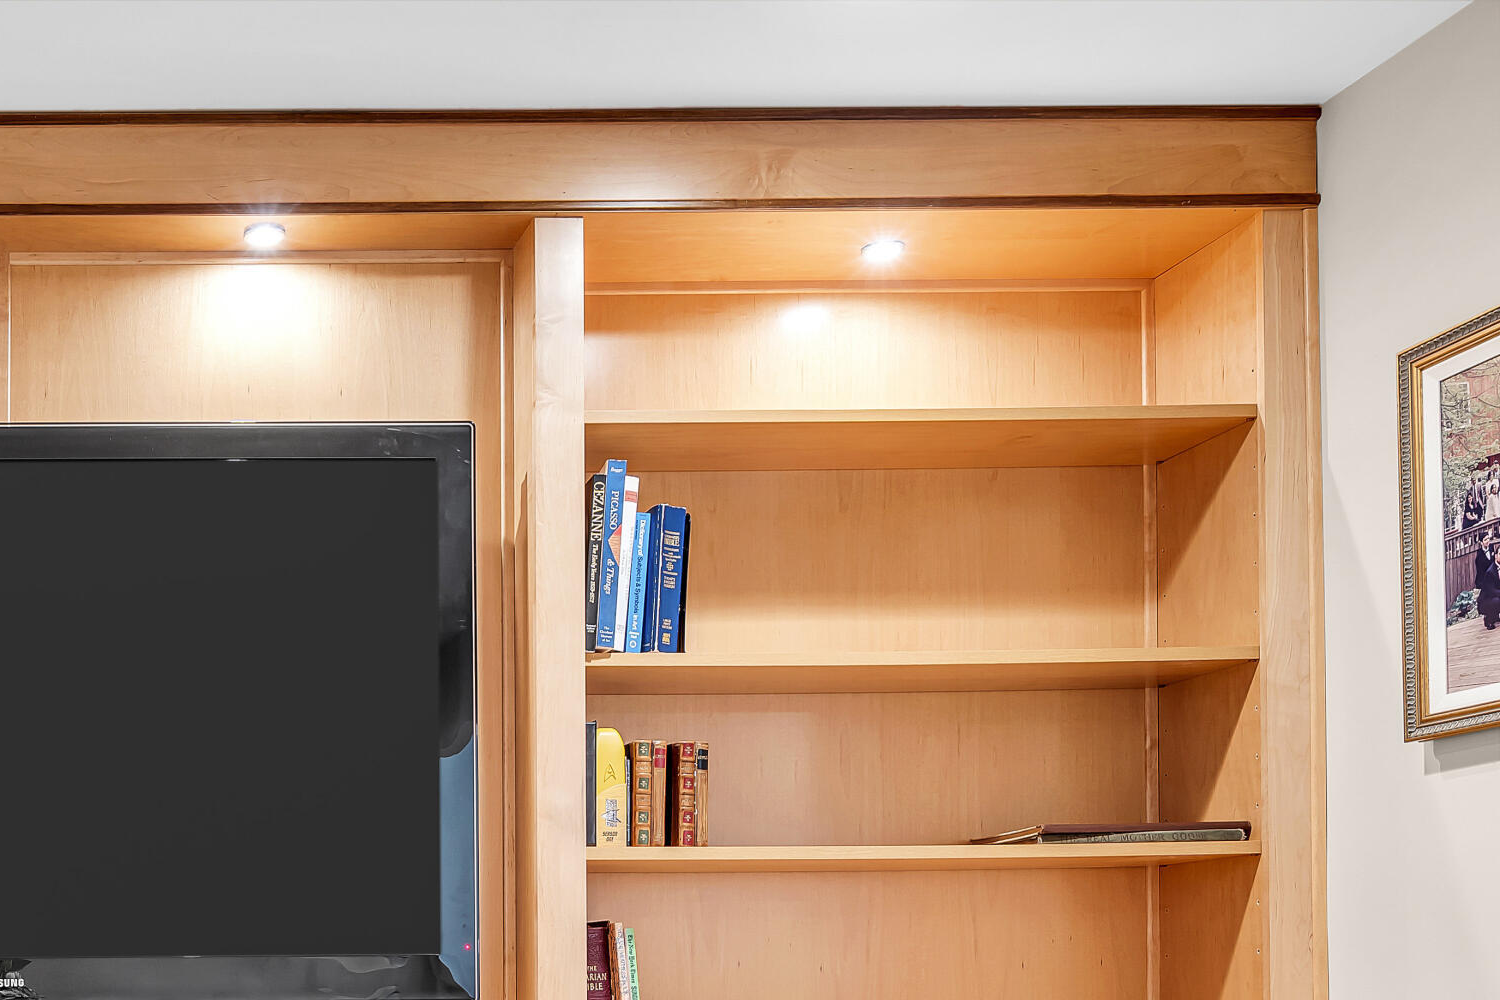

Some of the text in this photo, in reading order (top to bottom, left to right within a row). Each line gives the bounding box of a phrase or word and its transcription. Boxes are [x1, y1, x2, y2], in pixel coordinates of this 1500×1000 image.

[590, 481, 606, 541] CEZANNE
[604, 490, 620, 595] PICASSO & Things
[636, 519, 646, 548] Dictionary
[637, 548, 644, 556] of
[634, 556, 643, 582] Subjects
[632, 588, 641, 614] Symbols
[1120, 833, 1165, 842] MOTHER
[587, 973, 607, 981] RIAN
